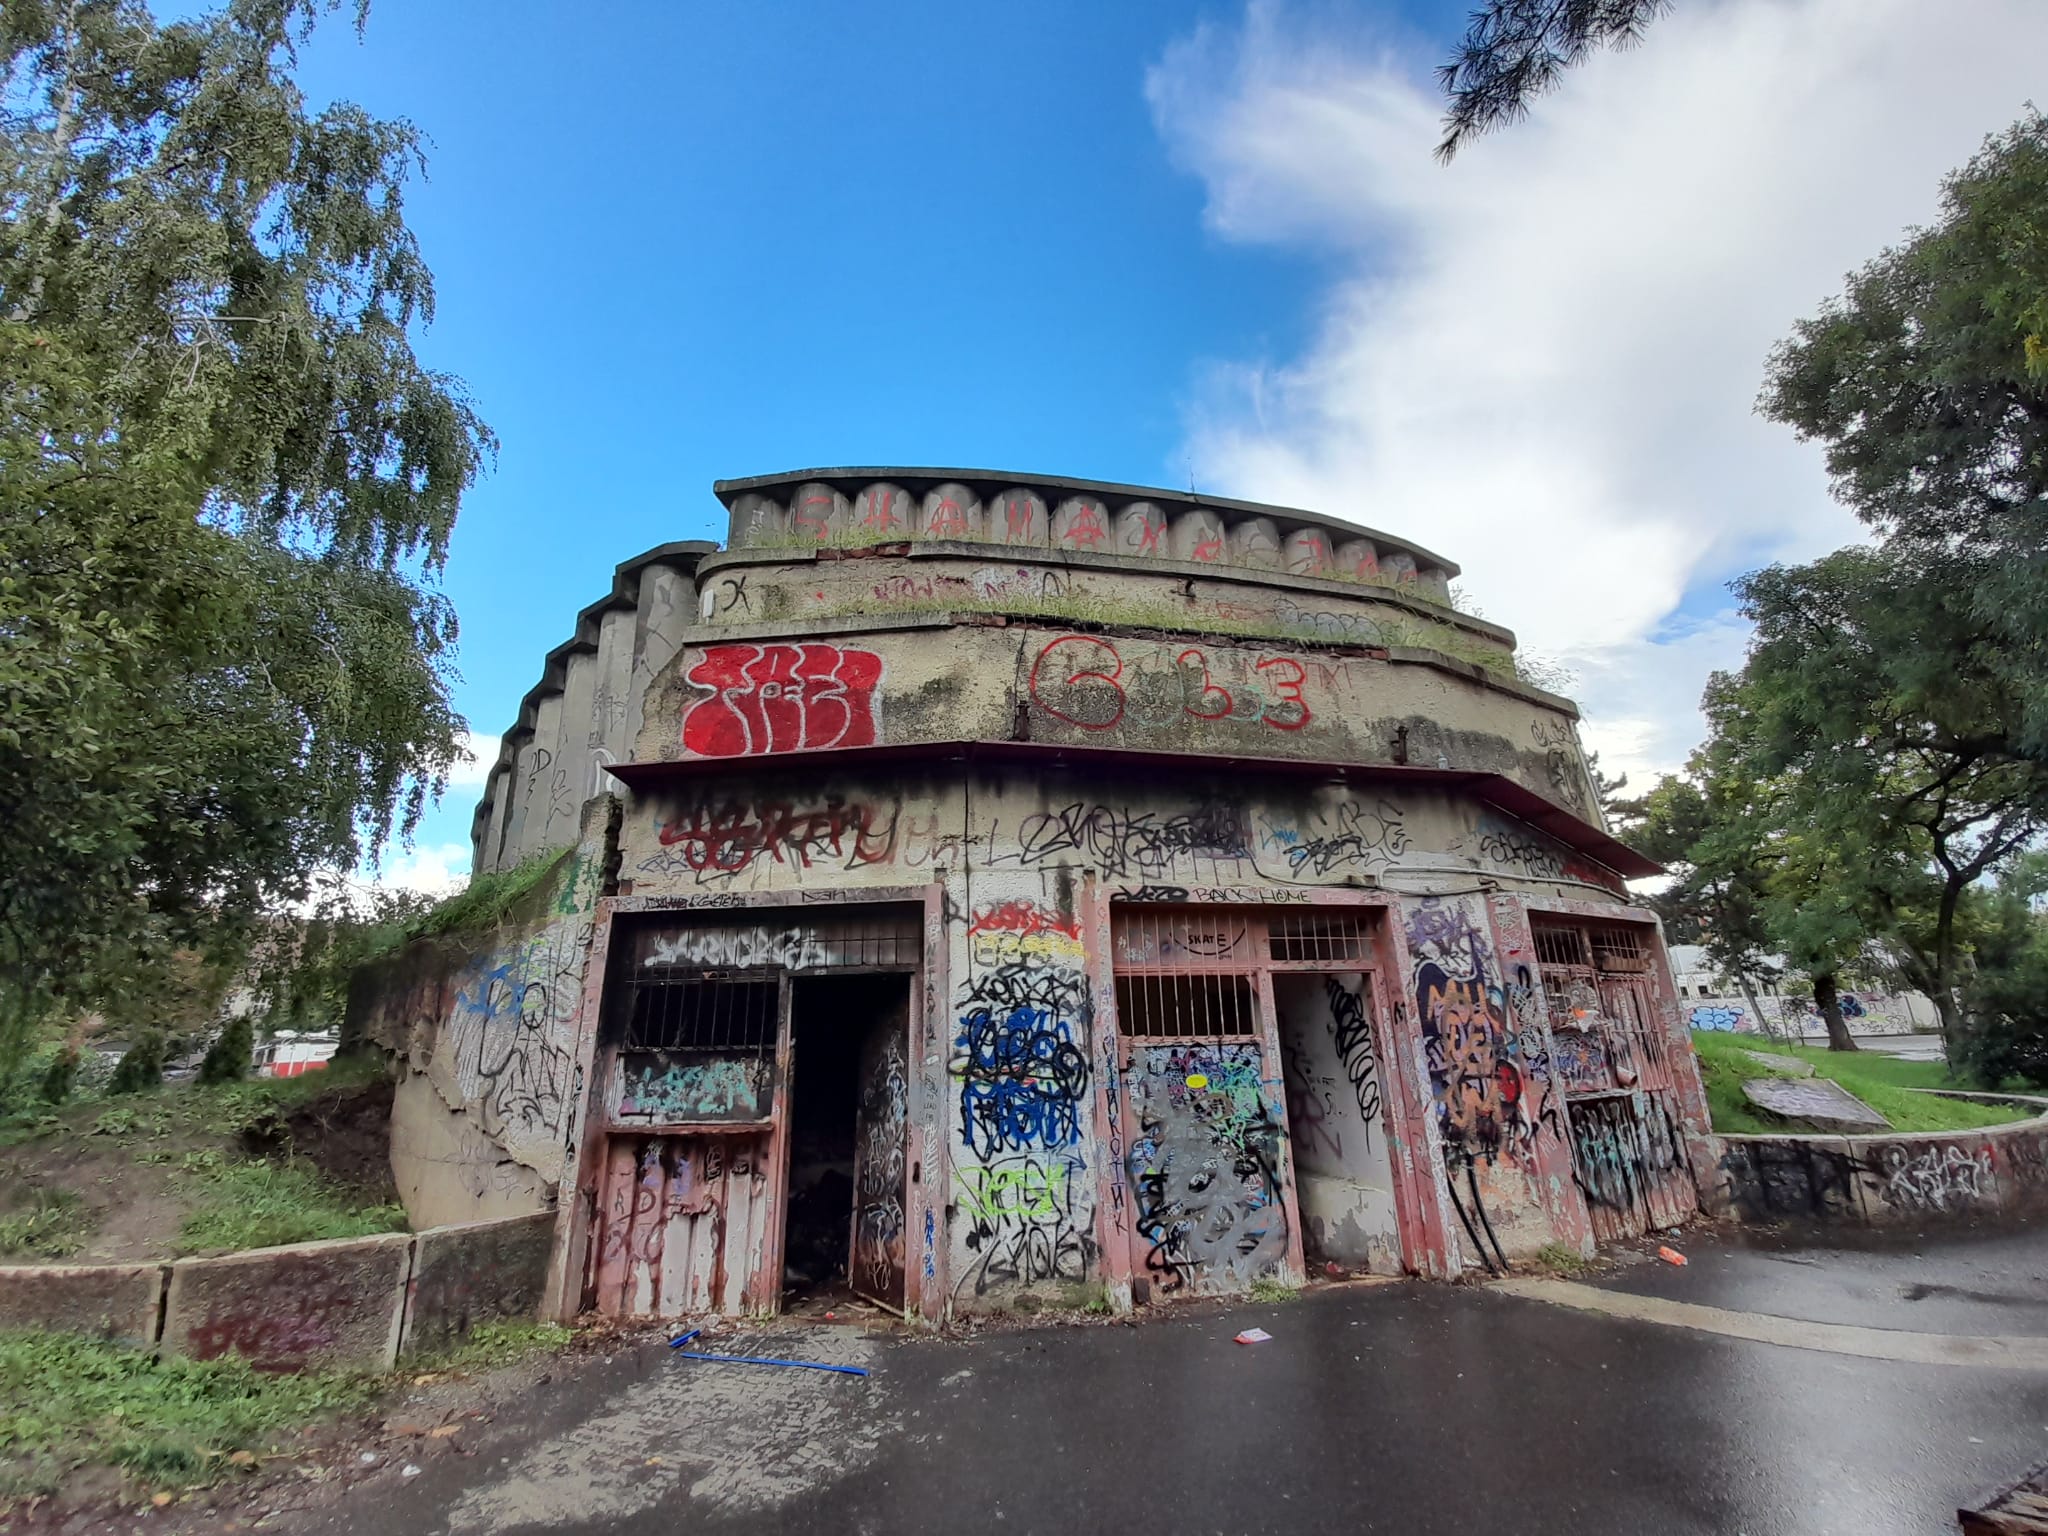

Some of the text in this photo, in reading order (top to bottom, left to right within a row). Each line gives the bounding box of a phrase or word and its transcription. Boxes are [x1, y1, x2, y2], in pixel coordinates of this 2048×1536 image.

[1193, 887, 1254, 903] BACK
[1259, 890, 1313, 904] HOME
[1188, 933, 1226, 947] SKATE
